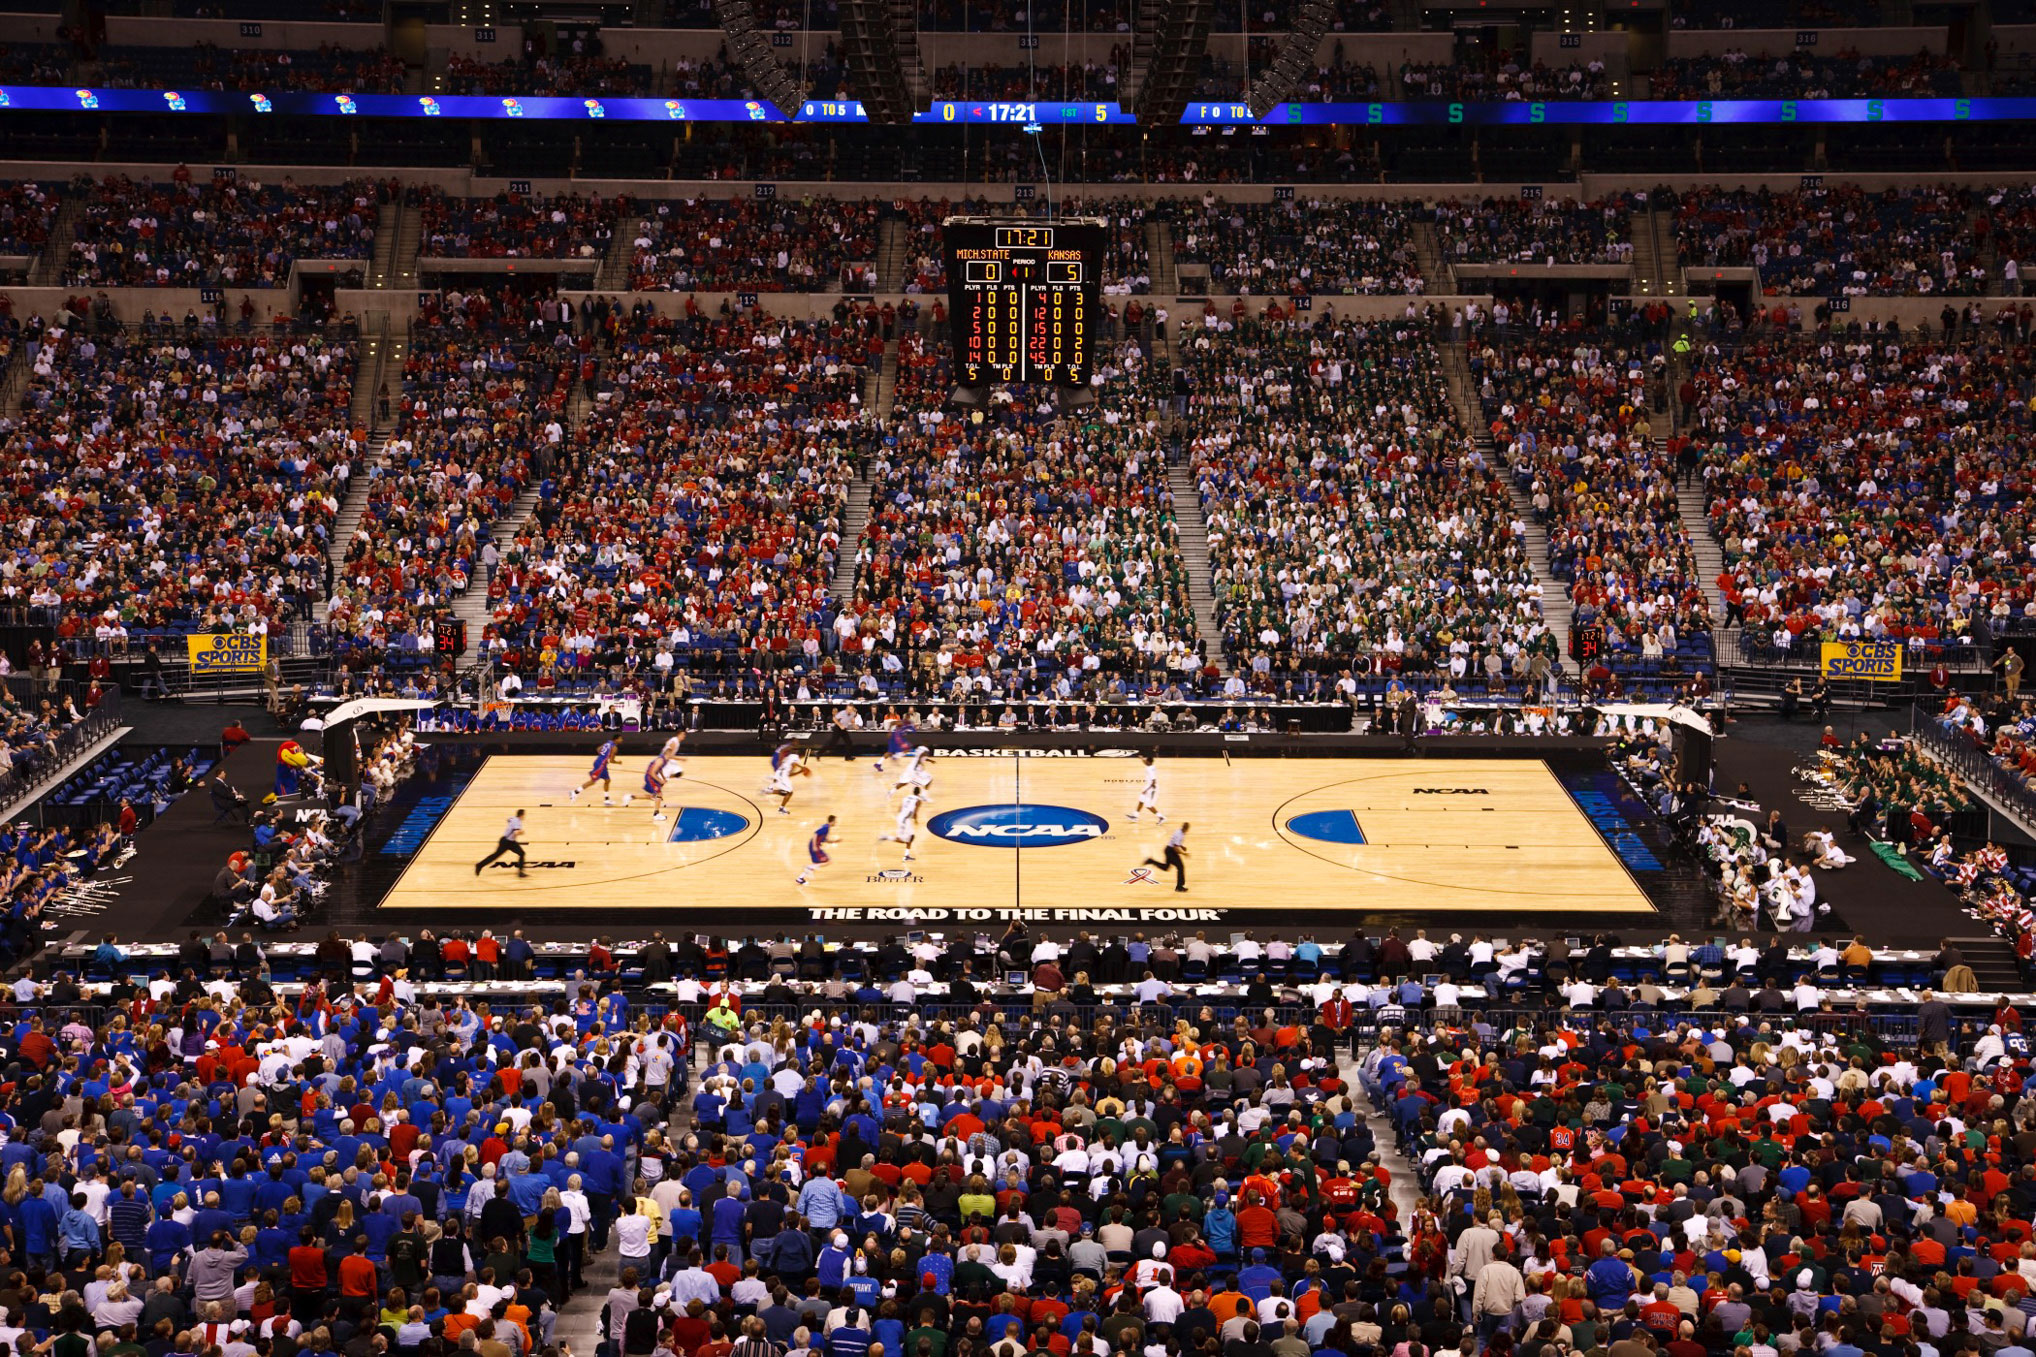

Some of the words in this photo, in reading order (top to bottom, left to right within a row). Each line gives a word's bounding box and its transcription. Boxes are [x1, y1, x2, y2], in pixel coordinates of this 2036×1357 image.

[241, 23, 260, 34] 310
[476, 30, 495, 40] 311
[774, 35, 792, 45] 312
[1561, 37, 1580, 46] 315
[943, 104, 955, 121] 0
[989, 104, 1036, 121] 17:21
[1061, 108, 1077, 117] 1ST
[1096, 104, 1107, 121] 5
[1200, 106, 1207, 118] F
[1288, 103, 1302, 123] S
[1368, 103, 1383, 123] S
[1448, 103, 1463, 123] S
[1530, 102, 1545, 123] S
[1613, 102, 1628, 123] S
[1697, 101, 1712, 122] S
[1781, 101, 1797, 121] S
[1867, 100, 1883, 120] S
[1955, 98, 1970, 120] S
[511, 183, 529, 192] 211
[1802, 178, 1821, 187] 216
[756, 186, 775, 195] 212
[1016, 188, 1034, 198] 213
[1275, 189, 1293, 198] 214
[1522, 188, 1541, 198] 215
[1007, 229, 1048, 246] 17:21
[1048, 249, 1081, 260] KANSAS
[985, 263, 995, 280] 0
[1067, 264, 1077, 281] 5
[988, 292, 996, 304] 0
[1009, 292, 1017, 304] 0
[1038, 293, 1046, 304] 4
[1053, 292, 1061, 305] 0
[1076, 292, 1083, 305] 3
[1829, 300, 1847, 309] 116
[973, 306, 981, 319] 2
[988, 306, 996, 319] 0
[1009, 306, 1017, 319] 0
[1034, 307, 1047, 320] 12
[1053, 307, 1061, 320] 0
[1075, 307, 1083, 320] 0
[973, 321, 981, 334] 5
[988, 321, 996, 334] 0
[1009, 321, 1017, 334] 0
[1034, 322, 1047, 335] 15
[1053, 322, 1061, 335] 0
[1075, 322, 1083, 335] 0
[968, 336, 981, 349] 10
[988, 336, 996, 349] 0
[1009, 336, 1017, 349] 0
[1029, 336, 1046, 349] 22
[1053, 337, 1061, 349] 0
[1074, 337, 1083, 349] 2
[968, 352, 981, 362] 14
[988, 351, 996, 363] 0
[1009, 351, 1017, 363] 0
[1029, 352, 1046, 364] 45
[1053, 352, 1061, 364] 0
[1074, 352, 1082, 364] 0
[968, 368, 976, 380] 5
[1003, 368, 1011, 380] 0
[1044, 368, 1052, 381] 0
[1070, 368, 1078, 381] 5
[226, 635, 262, 650] CBS
[439, 635, 454, 650] 34
[1582, 641, 1597, 657] 34
[1861, 643, 1897, 659] CBS
[195, 650, 261, 670] SPORTS
[1826, 658, 1895, 676] SPORTS
[933, 749, 1091, 758] BASKETBALL
[295, 809, 333, 823] NCA
[945, 824, 1103, 837] NCAA
[865, 875, 924, 883] BUTLER
[808, 908, 862, 920] THE
[866, 908, 949, 920] ROAD
[952, 908, 992, 920] TO
[994, 908, 1050, 921] THE
[1054, 908, 1138, 921] FINAL
[2009, 1038, 2028, 1051] 93
[1556, 1132, 1570, 1146] 34
